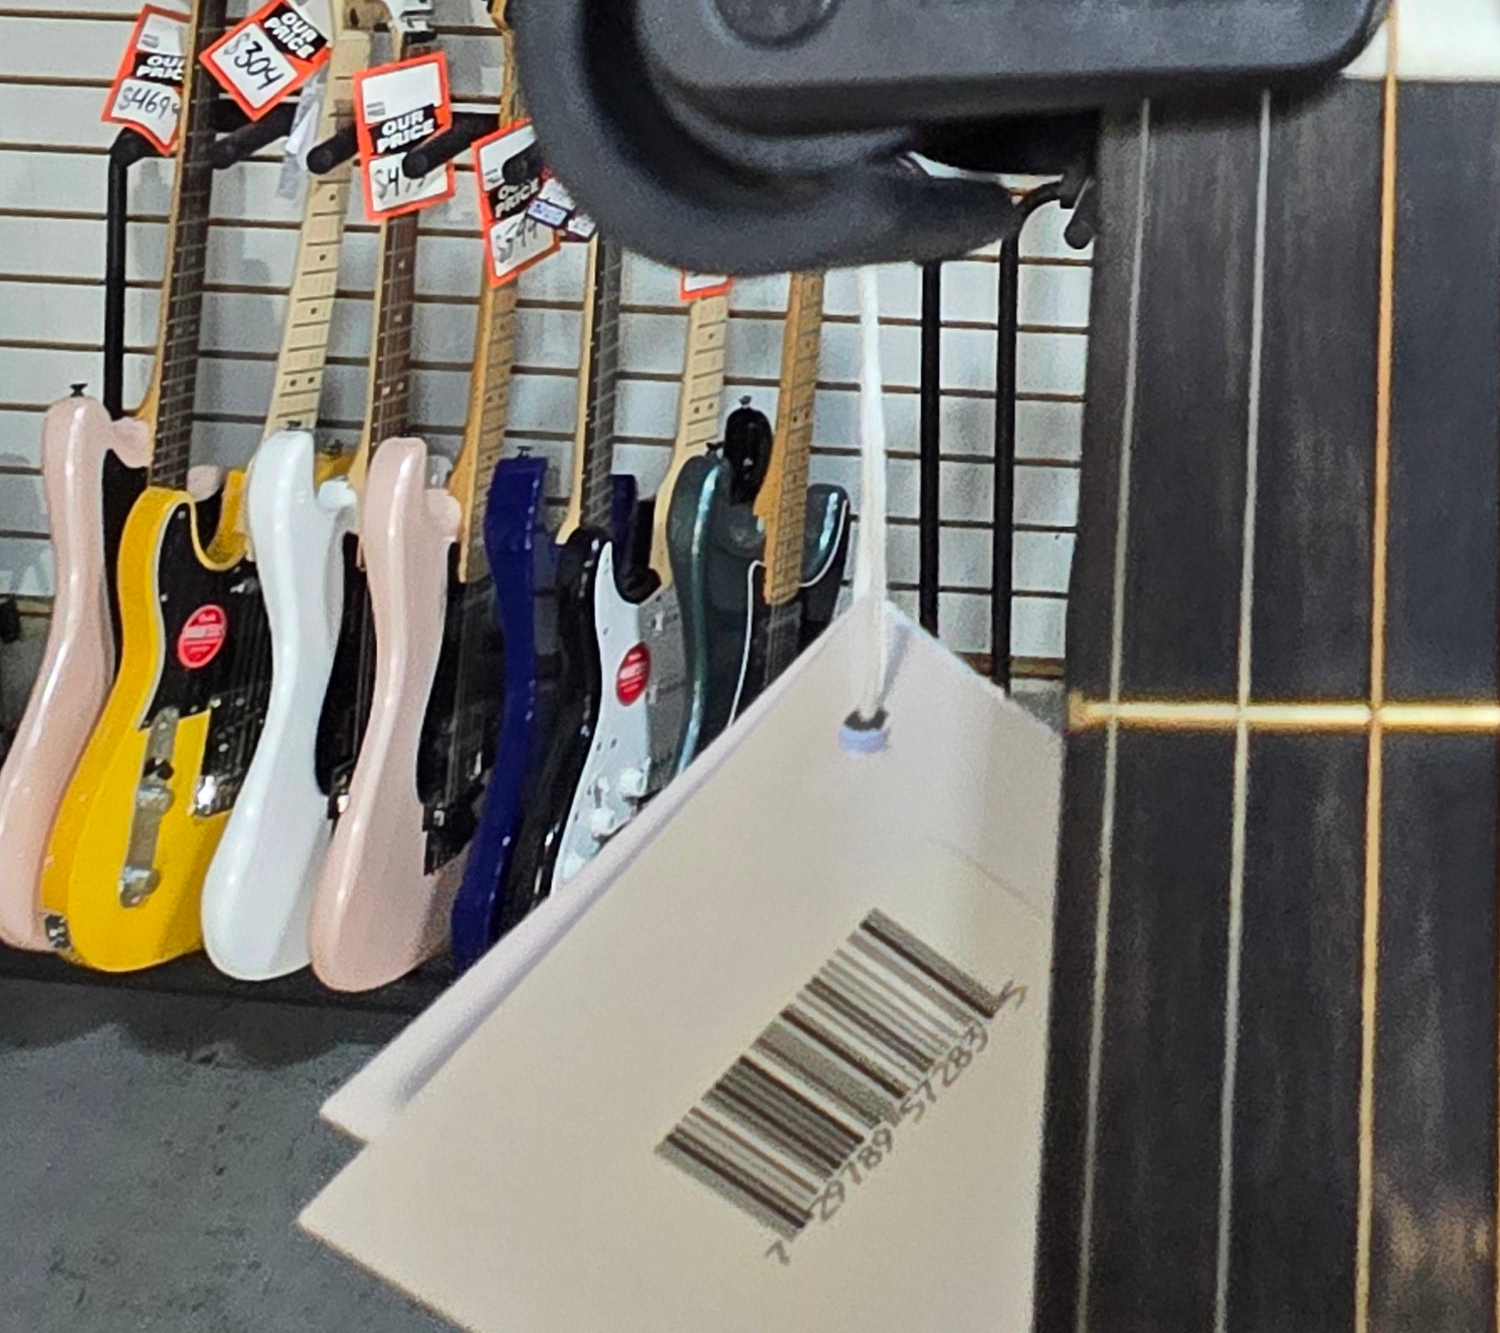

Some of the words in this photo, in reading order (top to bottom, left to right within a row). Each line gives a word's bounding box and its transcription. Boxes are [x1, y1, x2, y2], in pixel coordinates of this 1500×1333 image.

[263, 16, 316, 60] PRICE
[280, 11, 318, 43] OUR
[136, 64, 186, 81] PRIC
[223, 32, 286, 91] $304
[376, 118, 435, 154] PRICE
[381, 109, 425, 137] OUR
